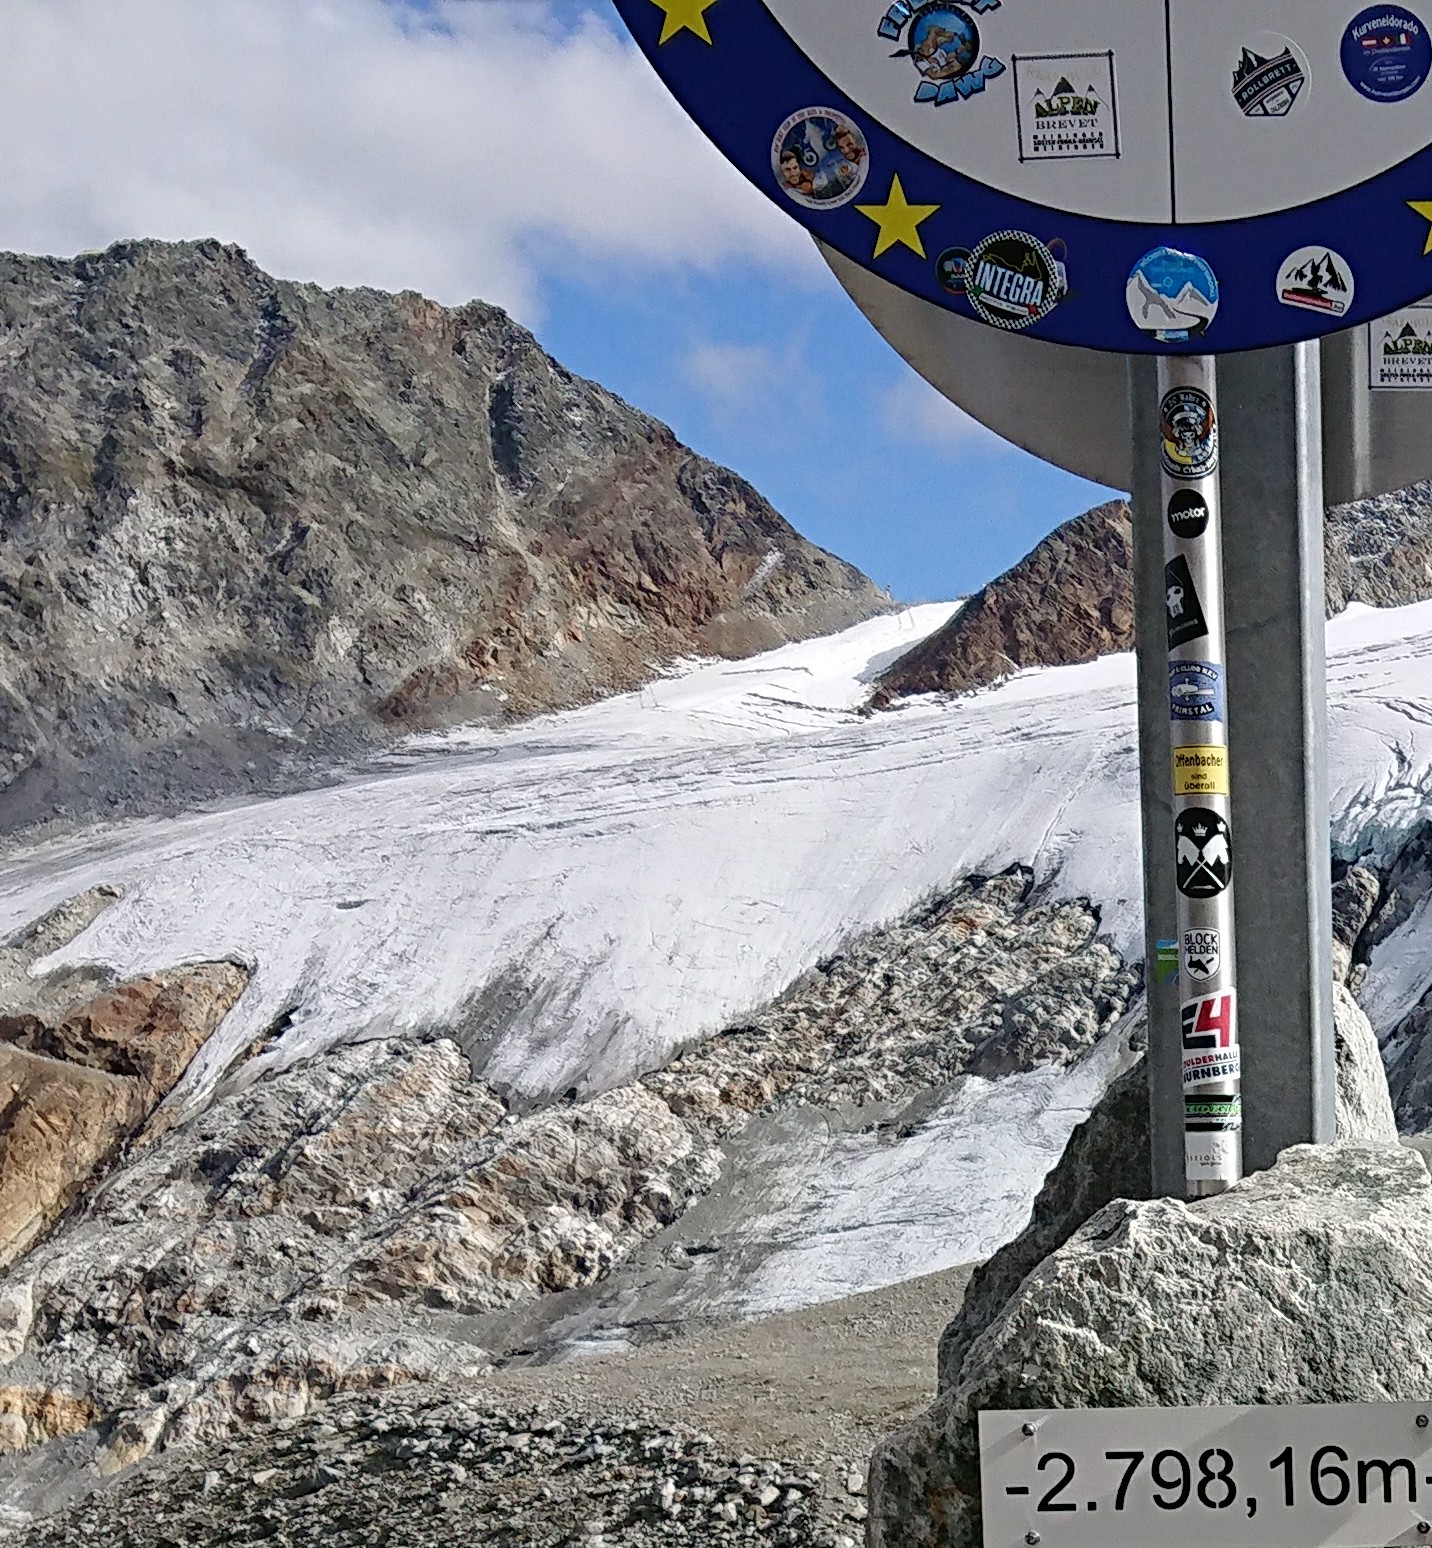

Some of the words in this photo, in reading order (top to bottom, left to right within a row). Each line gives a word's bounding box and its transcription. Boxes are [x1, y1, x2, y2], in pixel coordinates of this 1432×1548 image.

[1352, 14, 1419, 41] Kurveneldorado
[1241, 63, 1291, 100] ROLLBRETT
[1035, 96, 1101, 118] ALPEN
[1035, 119, 1098, 130] BREVET
[975, 259, 1044, 305] INTEGRA
[1171, 507, 1205, 523] motor
[1185, 933, 1217, 945] BLOCK
[1185, 945, 1218, 955] HELDEN
